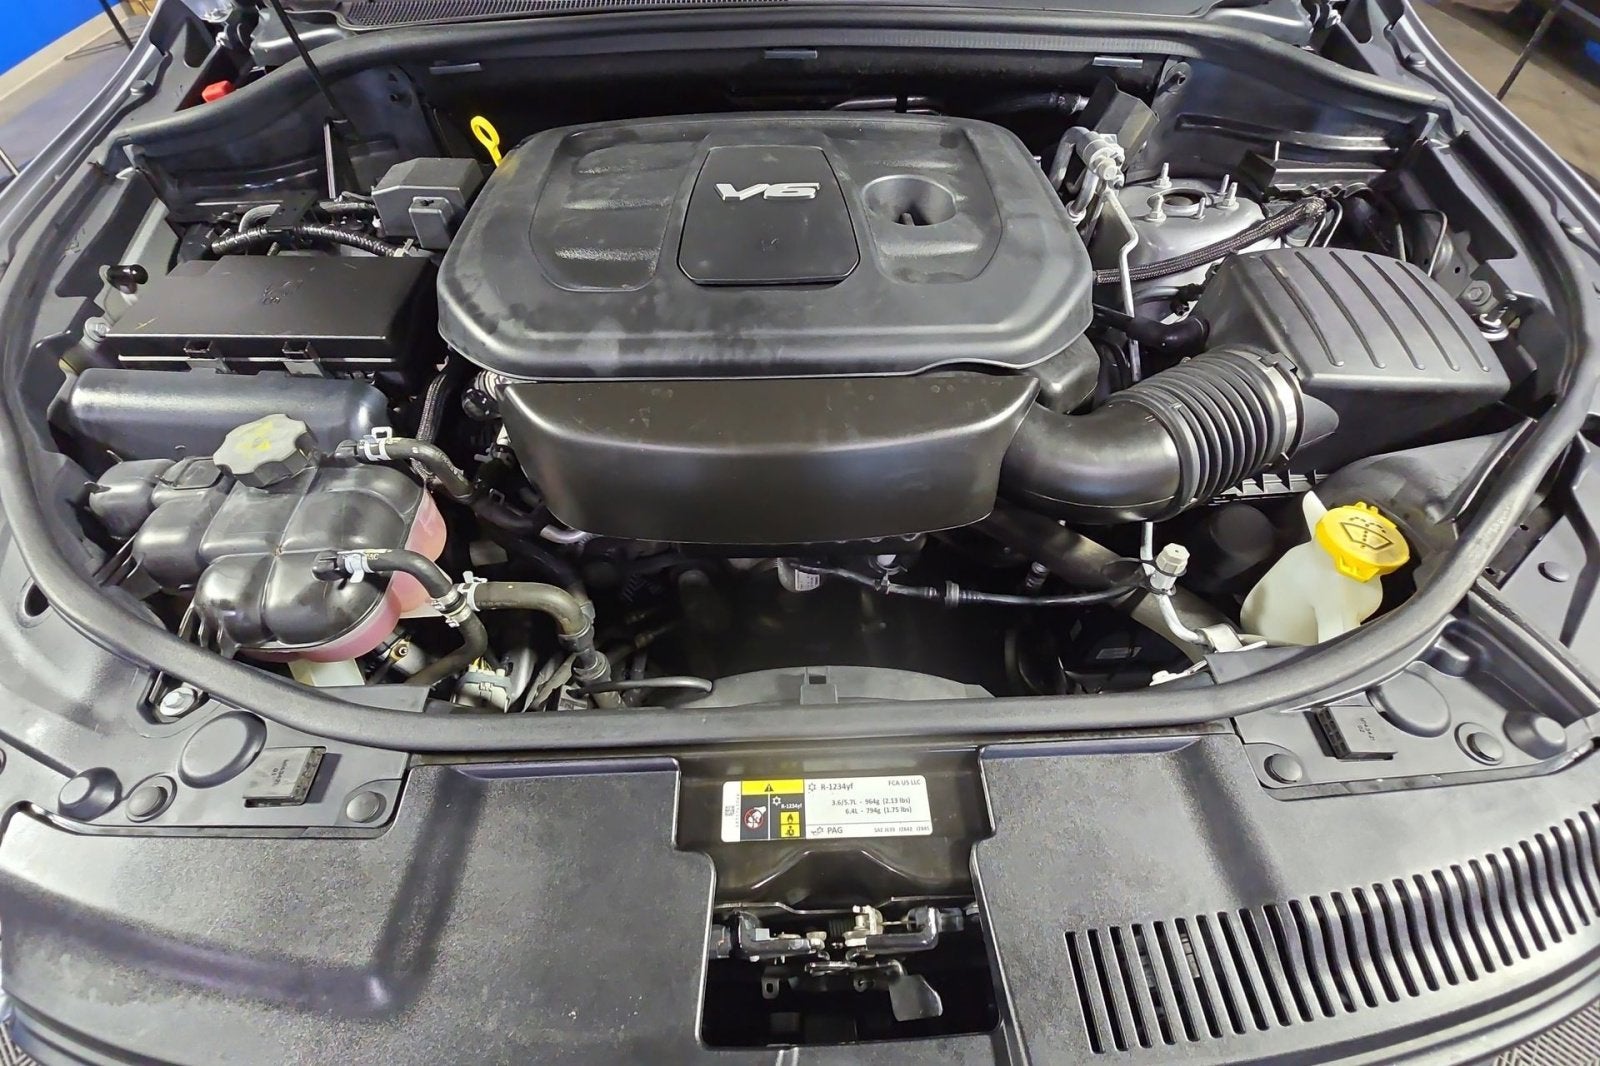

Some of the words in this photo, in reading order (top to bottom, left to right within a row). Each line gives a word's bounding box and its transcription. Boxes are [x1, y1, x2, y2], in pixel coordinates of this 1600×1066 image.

[715, 182, 820, 201] V6
[820, 782, 854, 791] R-1234yf
[827, 826, 843, 834] PAG
